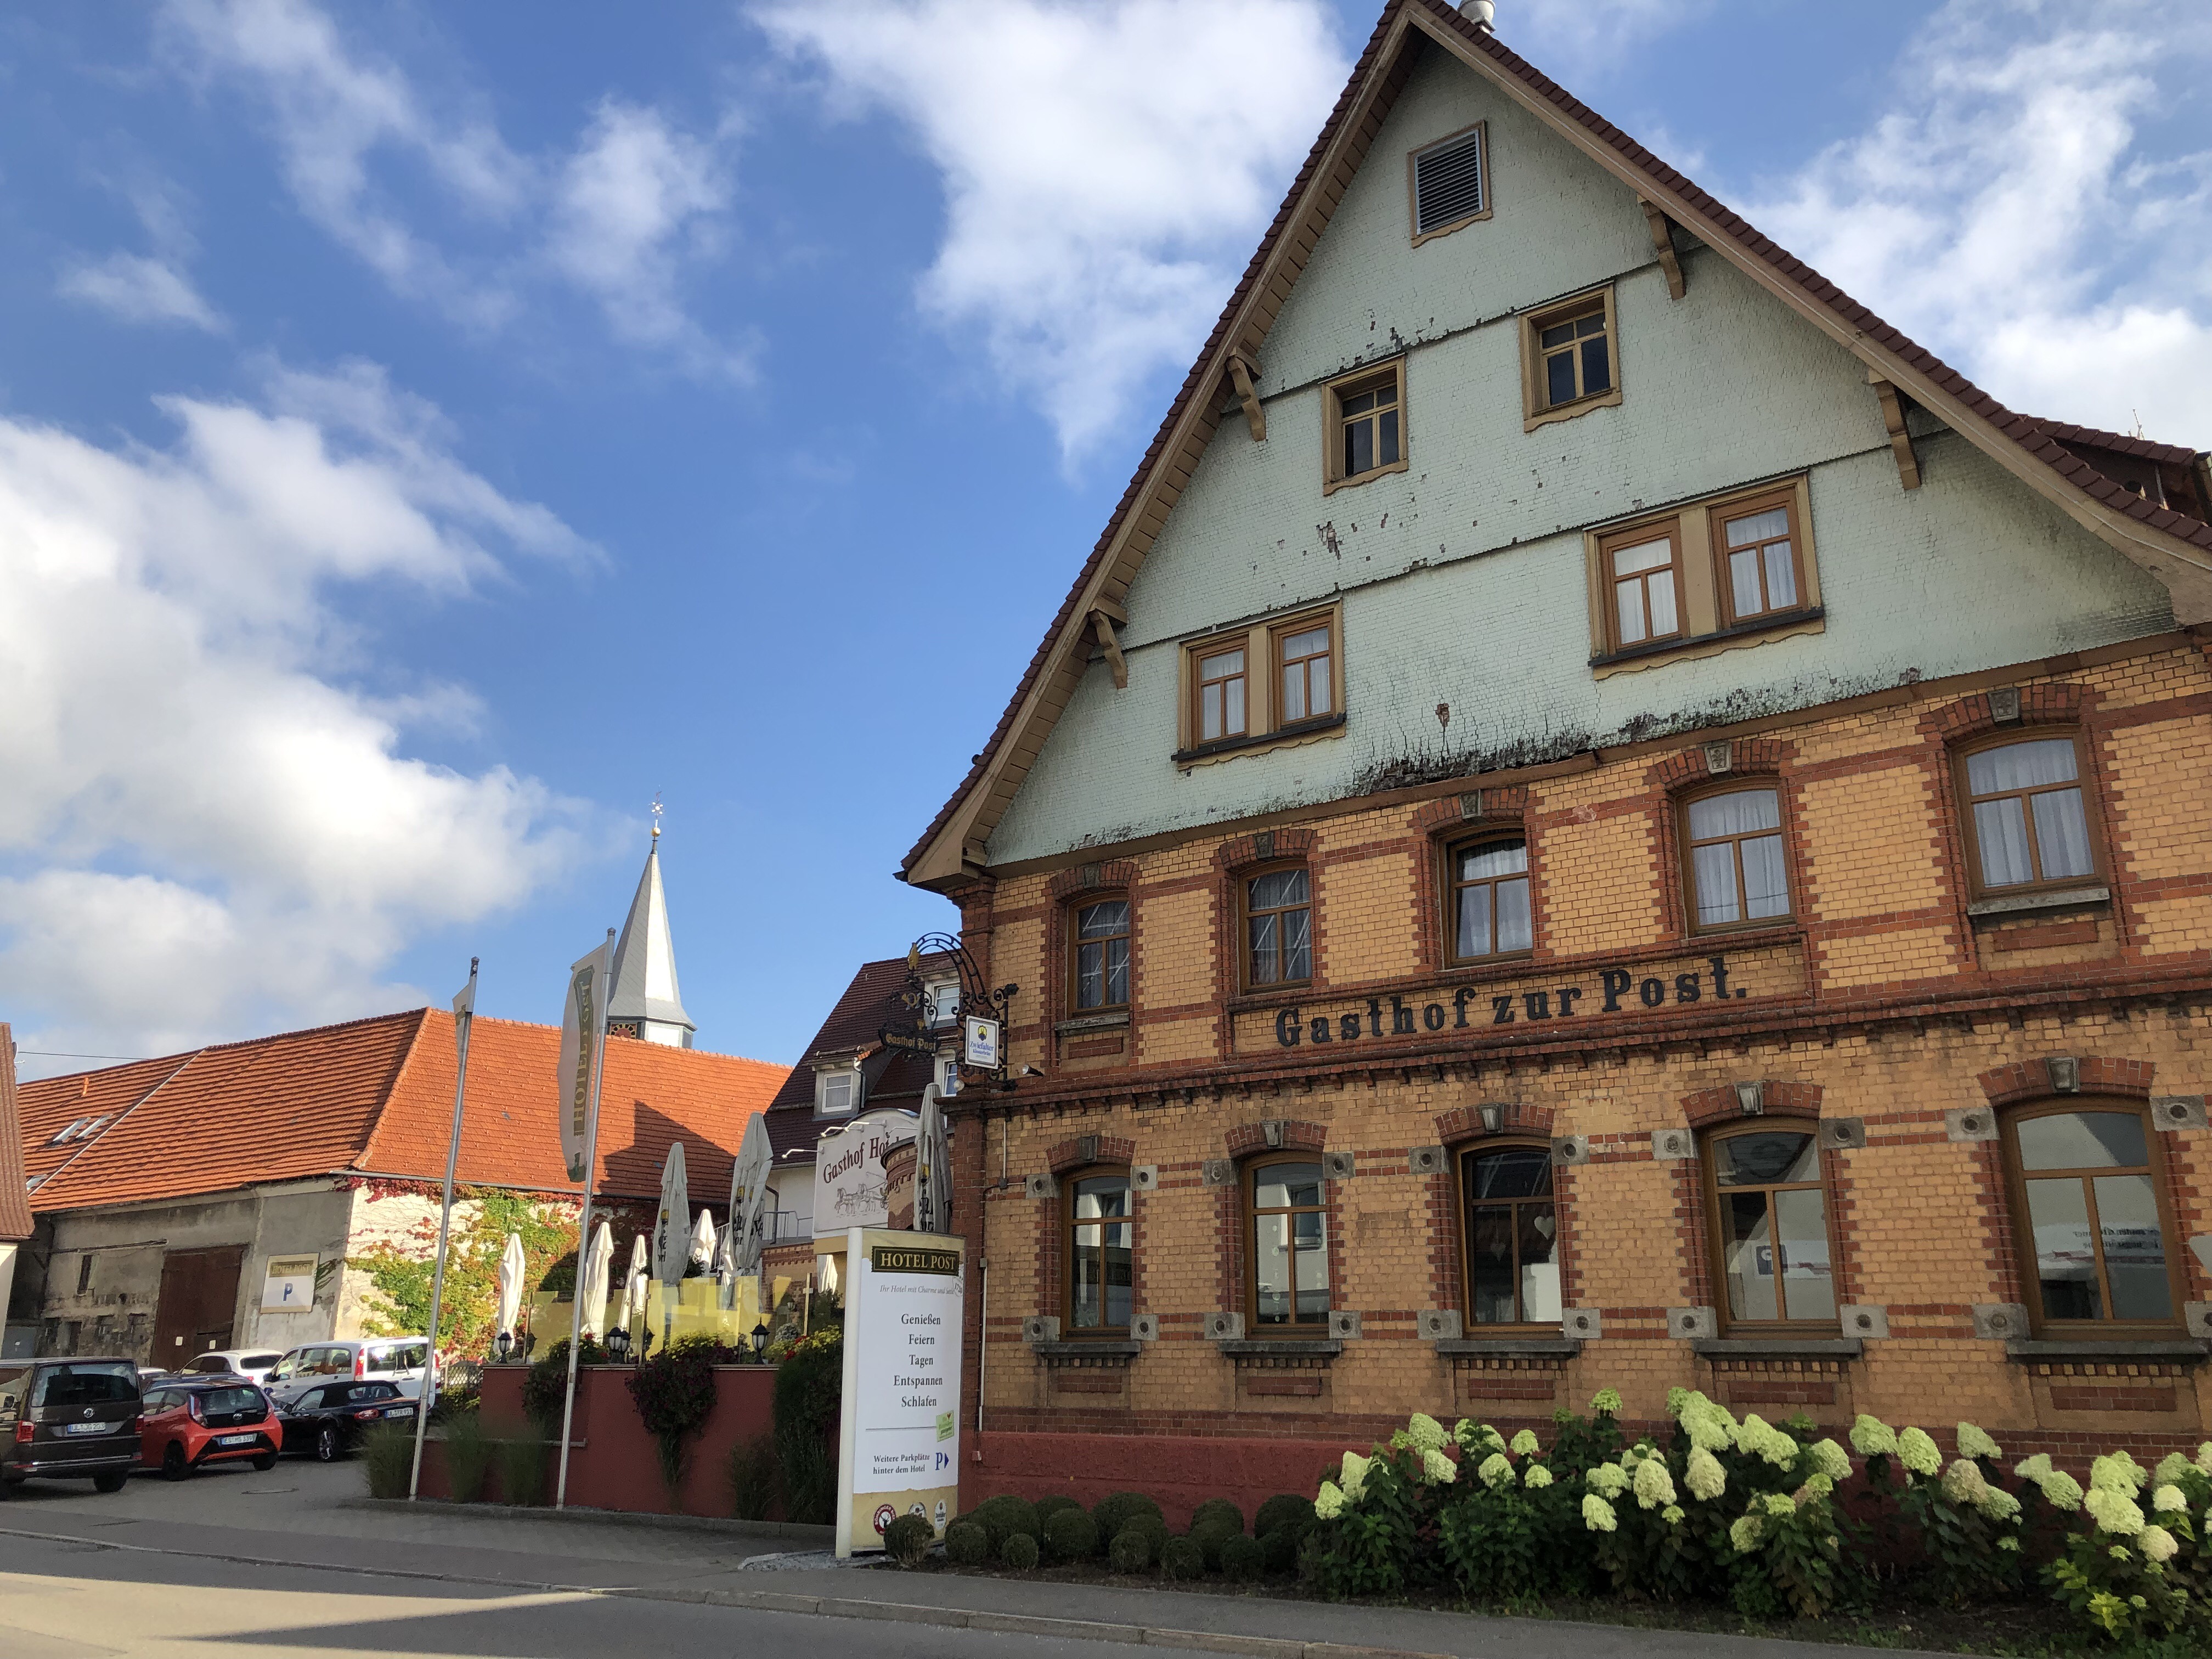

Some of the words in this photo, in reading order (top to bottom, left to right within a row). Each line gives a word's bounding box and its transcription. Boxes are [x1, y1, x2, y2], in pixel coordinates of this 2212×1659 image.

[579, 981, 590, 1036] OST
[1276, 988, 1476, 1047] Gasthof
[1493, 988, 1581, 1024] zur
[1600, 957, 1746, 1012] Post.
[886, 1033, 915, 1048] Gasthof
[917, 1037, 936, 1052] Post
[574, 1044, 588, 1121] HOTEL
[823, 1142, 865, 1183] Gasthof
[881, 1252, 928, 1268] HOTEL
[930, 1255, 956, 1269] POST
[272, 1265, 292, 1274] HOTEL
[283, 1283, 292, 1301] P
[901, 1314, 941, 1325] Genießen
[909, 1334, 935, 1345] Feiern
[909, 1355, 933, 1368] Tagen
[894, 1375, 943, 1389] Entspannen
[901, 1396, 937, 1407] Schlafen
[901, 1454, 930, 1463] Parkplätze
[935, 1452, 943, 1470] P
[895, 1465, 909, 1474] dem
[910, 1464, 925, 1473] Hotel
